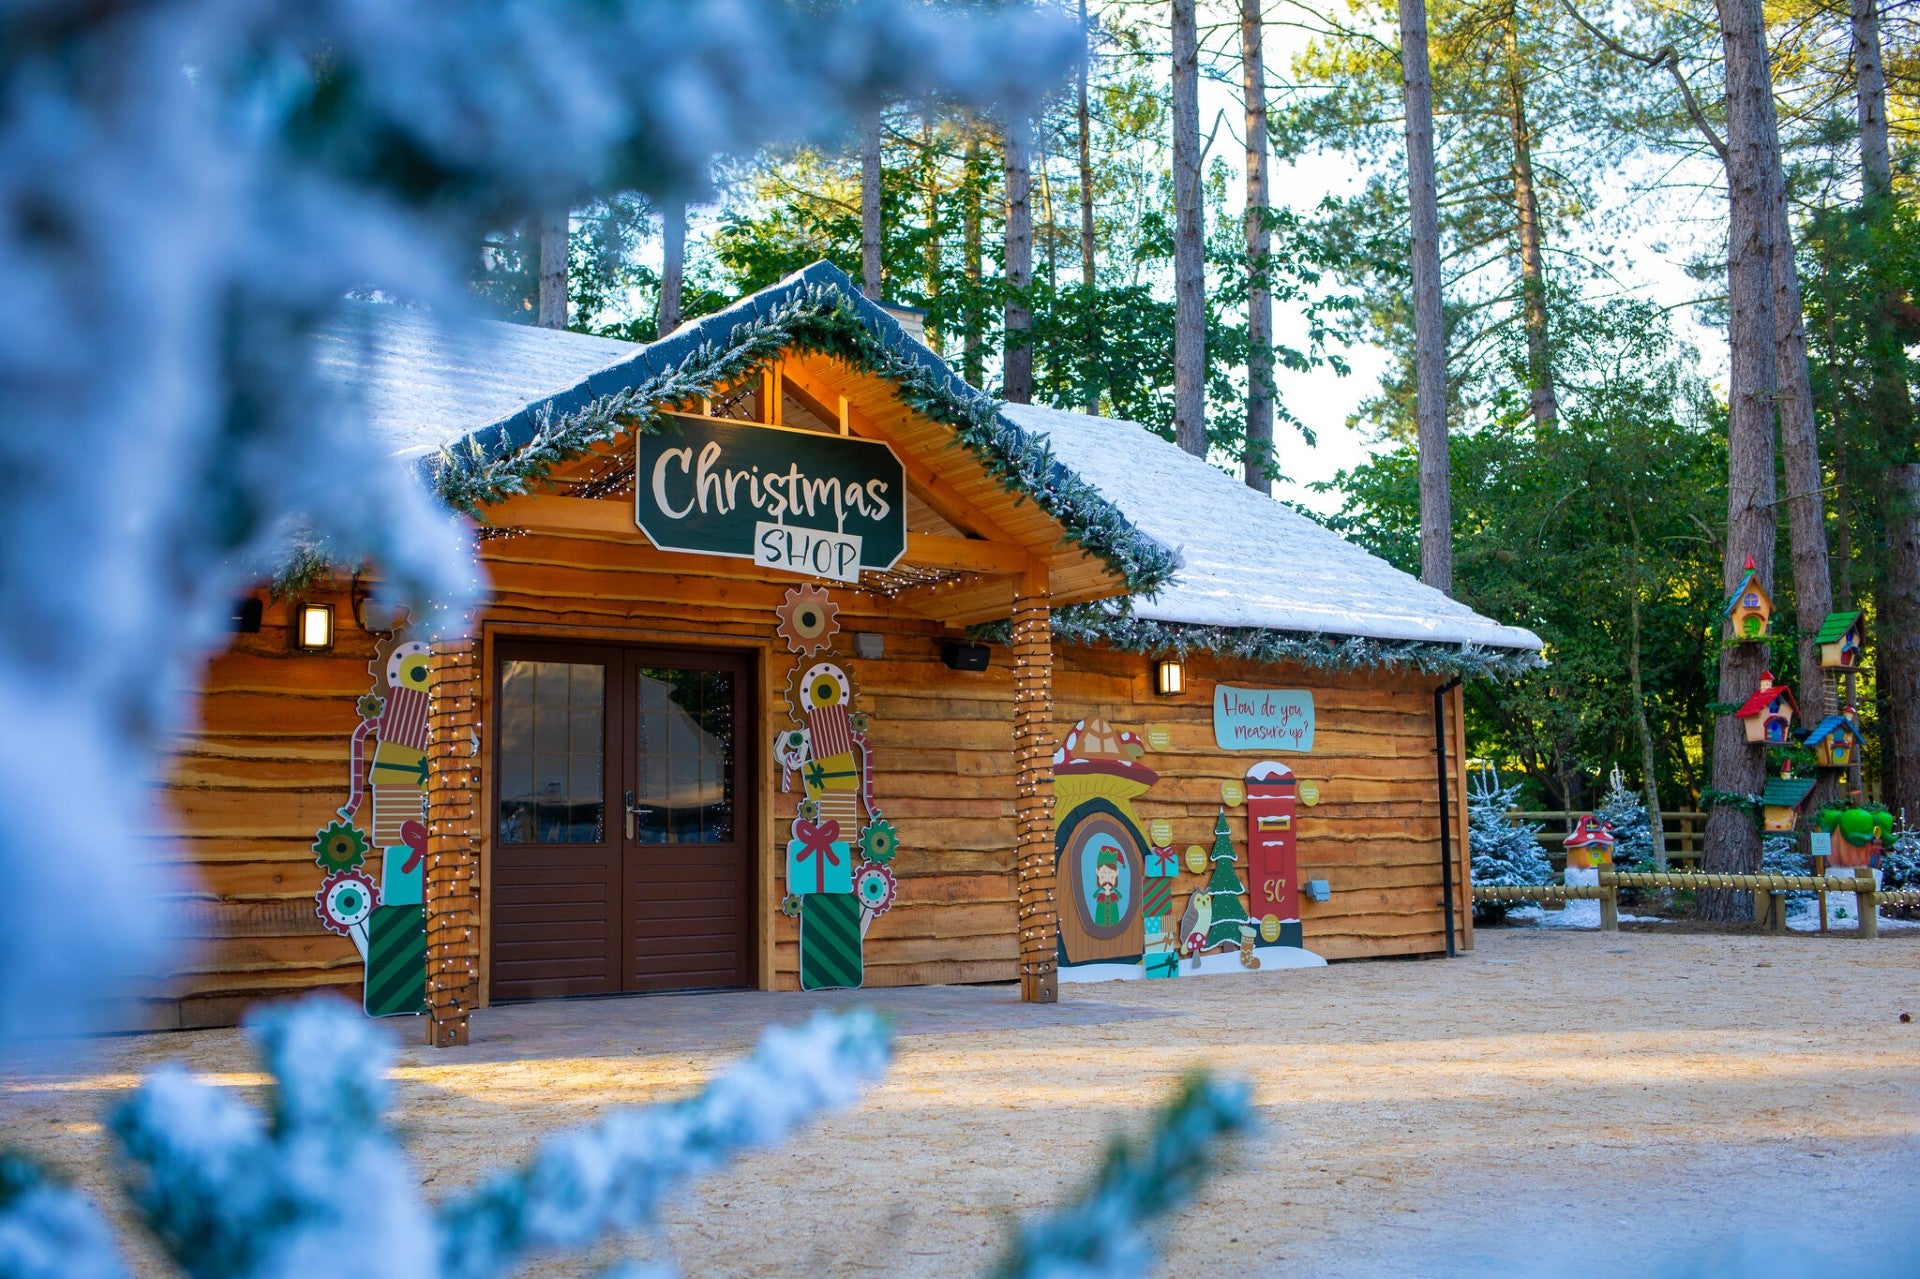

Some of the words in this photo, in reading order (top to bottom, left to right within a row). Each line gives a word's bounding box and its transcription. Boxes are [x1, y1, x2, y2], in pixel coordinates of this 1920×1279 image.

[652, 440, 891, 520] Christmas
[761, 529, 857, 576] SHOP
[1223, 692, 1255, 717] How
[1261, 693, 1277, 717] do
[1280, 703, 1302, 727] you
[1234, 725, 1287, 740] measure
[1288, 720, 1309, 748] up?
[1263, 878, 1287, 903] SC
